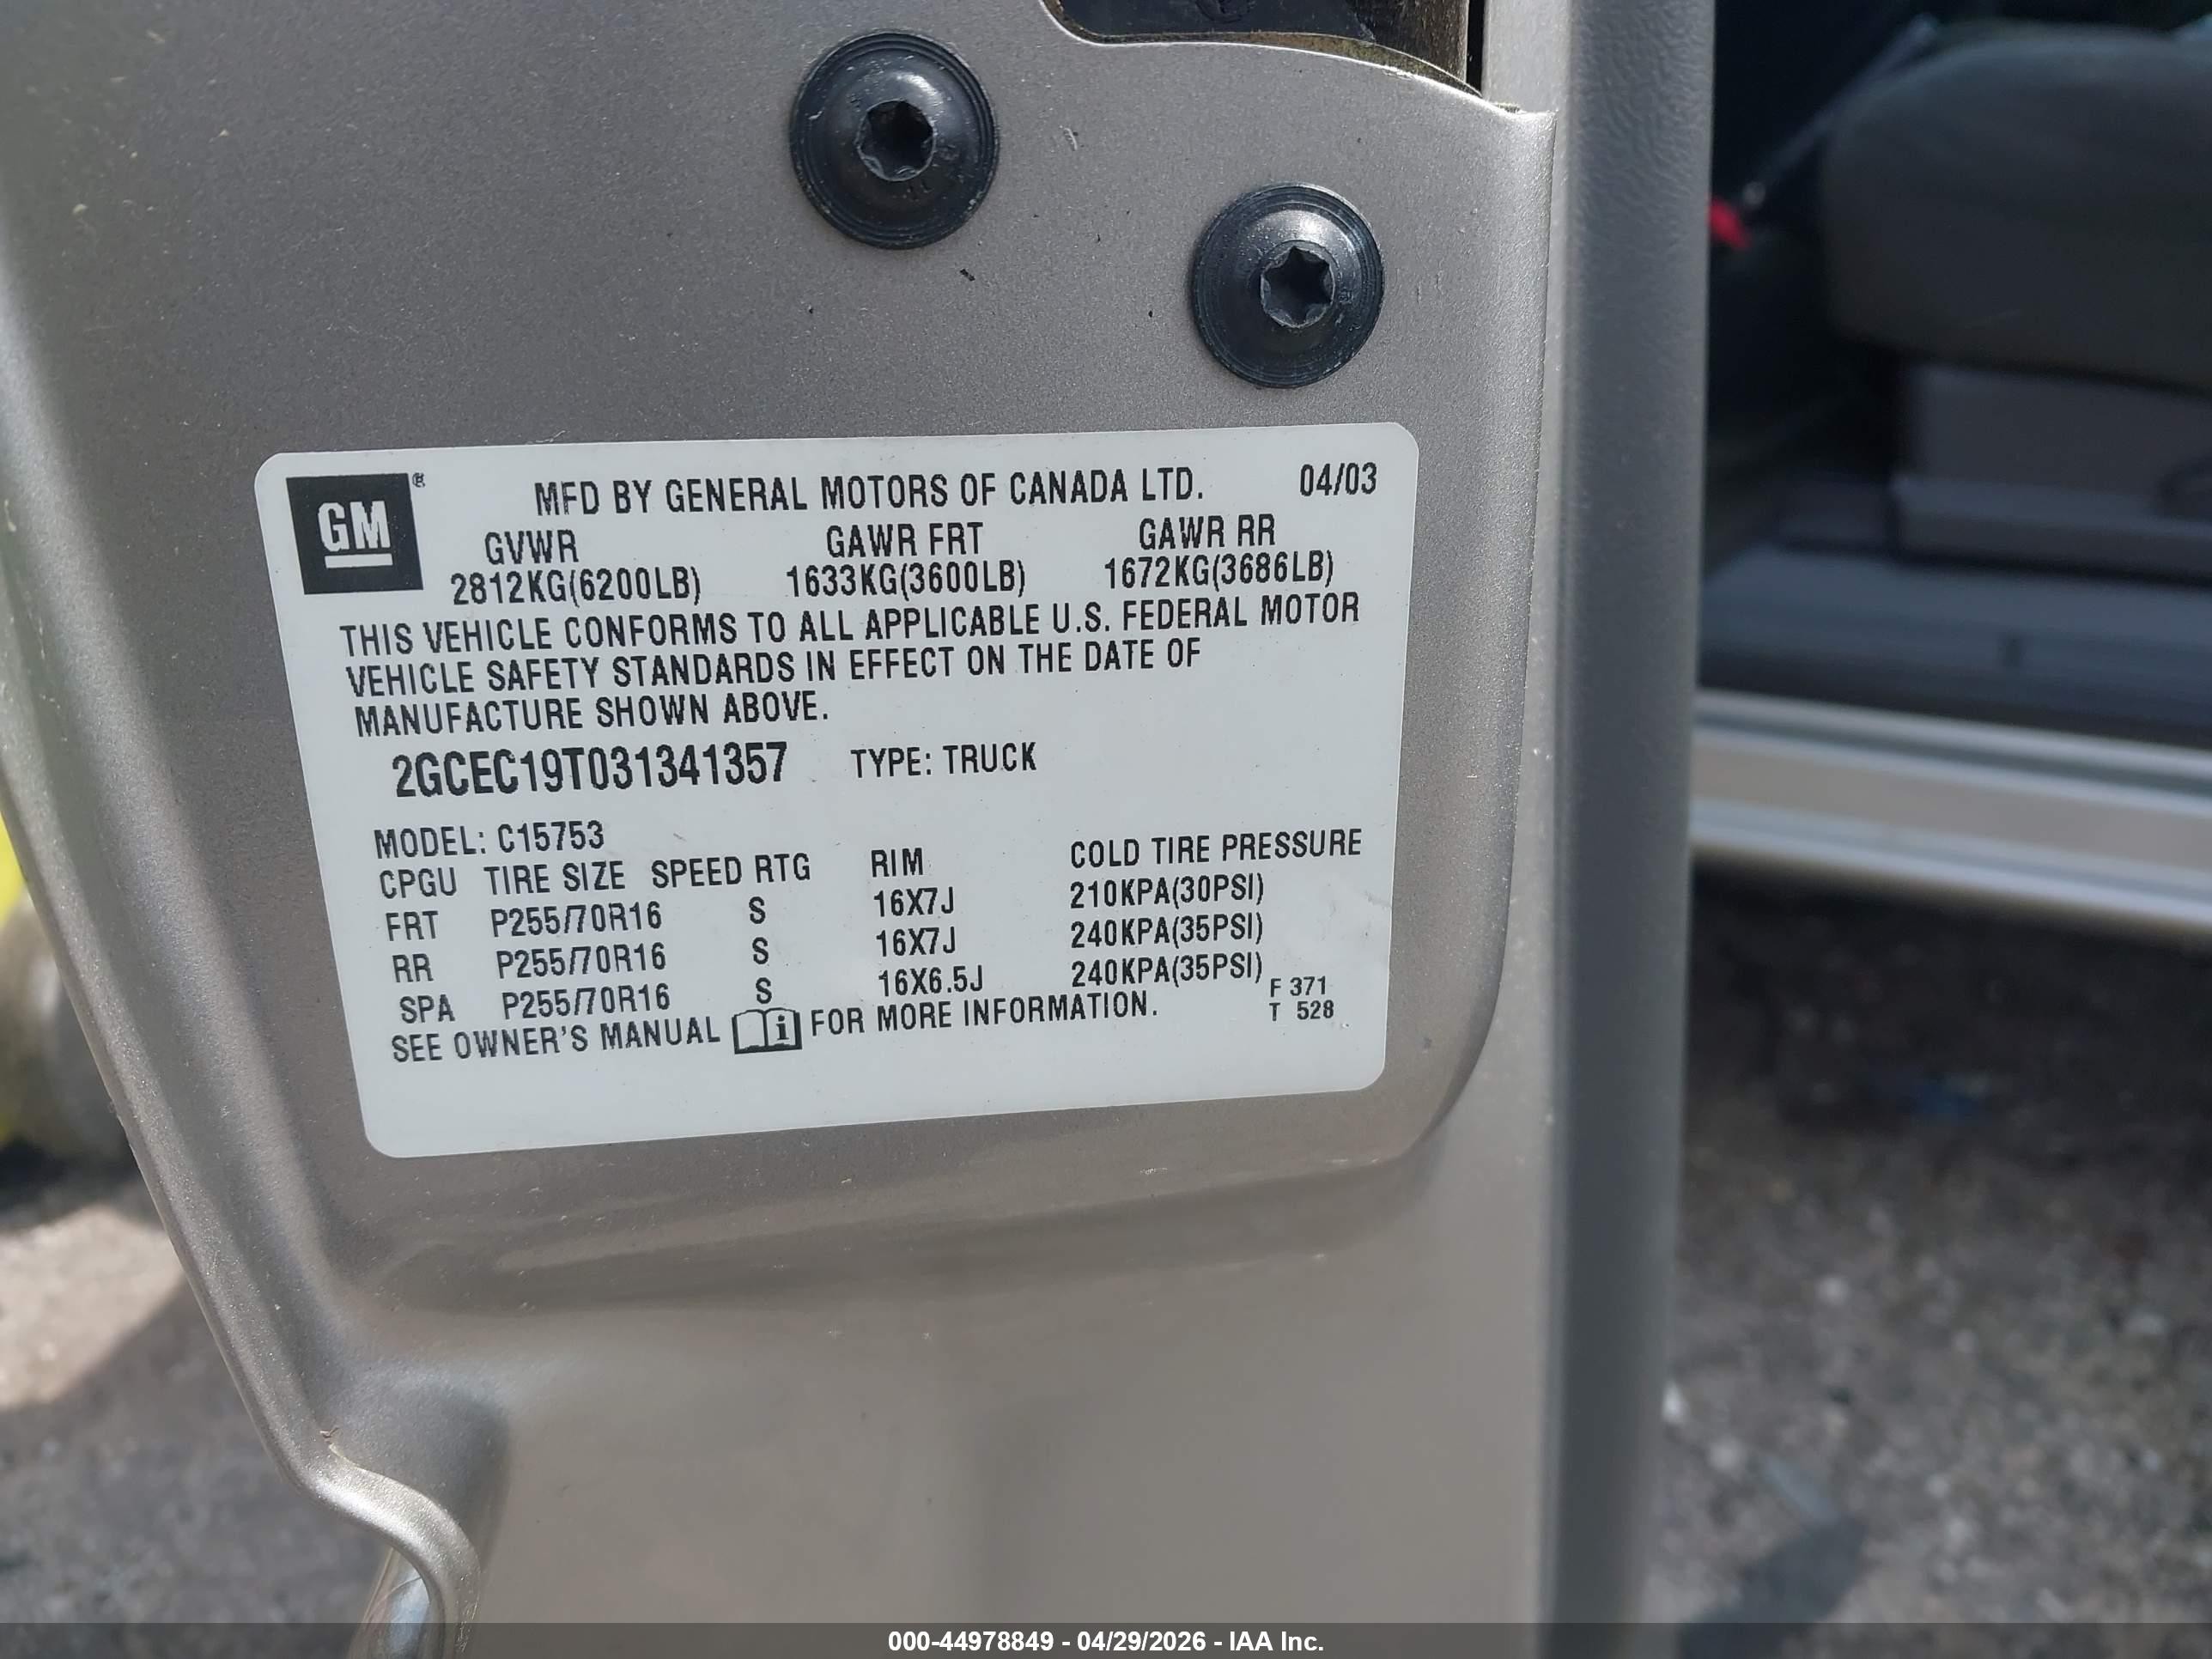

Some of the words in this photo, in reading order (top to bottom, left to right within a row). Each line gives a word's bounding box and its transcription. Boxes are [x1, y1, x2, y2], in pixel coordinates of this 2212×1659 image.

[534, 481, 599, 515] MFD
[613, 480, 652, 514] BY
[665, 477, 807, 513] GENERAL
[821, 474, 947, 509] MOTORS
[961, 473, 995, 506] OF
[1011, 469, 1127, 505] CANADA
[1143, 467, 1202, 501] LTD.
[1300, 462, 1376, 496] 04/03
[319, 501, 390, 551] GM
[827, 524, 917, 557] GAWR
[929, 522, 983, 555] FRT
[1139, 515, 1224, 550] GAWR
[1238, 514, 1274, 546] RR
[484, 529, 579, 565] GVWR
[451, 566, 701, 607] 2812KG(6200LB)
[787, 560, 1024, 601] 1633KG(3600LB)
[1104, 550, 1334, 592] 1672KG(3686LB)
[339, 623, 412, 656] THIS
[422, 617, 551, 653] VEHICLE
[565, 613, 737, 647] CONFORMS
[747, 611, 785, 643] TO
[799, 610, 854, 641] ALL
[866, 604, 1039, 640] APPLICABLE
[1053, 602, 1109, 633] U.S.
[1124, 597, 1247, 630] FEDERAL
[1261, 592, 1358, 625] MOTOR
[346, 661, 474, 697] VEHICLE
[487, 657, 599, 691] SAFETY
[613, 652, 794, 687] STANDARDS
[807, 651, 835, 681] IN
[850, 647, 954, 680] EFFECT
[968, 645, 1004, 675] ON
[1018, 642, 1072, 673] THE
[1085, 639, 1153, 671] DATE
[1168, 637, 1200, 667] OF
[355, 698, 582, 737] MANUFACTURE
[596, 694, 708, 727] SHOWN
[724, 690, 828, 723] ABOVE.
[392, 741, 787, 797] 2GCEC19T031341357
[850, 747, 931, 778] TYPE:
[943, 742, 1036, 774] TRUCK
[374, 826, 485, 859] MODEL:
[497, 820, 604, 853] C15753
[1071, 839, 1139, 868] COLD
[1152, 836, 1209, 864] TIRE
[1223, 829, 1362, 860] PRESSURE
[380, 867, 457, 899] CPGU
[483, 865, 550, 895] TIRE
[562, 860, 625, 891] SIZE
[652, 856, 742, 888] SPEED
[755, 853, 810, 883] RTG
[872, 848, 923, 878] RIM
[874, 886, 953, 917] 16X7J
[1071, 873, 1263, 909] 210KPA(30PSI)
[386, 910, 438, 941] FRT
[490, 901, 661, 937] P255/70R16
[749, 896, 766, 924] S
[876, 927, 955, 957] 16X7J
[1071, 912, 1262, 949] 240KPA(35PSI)
[392, 953, 433, 982] RR
[496, 942, 665, 979] P255/70R16
[752, 937, 769, 964] S
[878, 965, 982, 997] 16X6.5J
[1072, 951, 1261, 988] 240KPA(35PSI)
[1270, 978, 1281, 998] F
[1291, 975, 1326, 996] 371
[502, 983, 670, 1019] P255/70R16
[756, 977, 772, 1004] S
[399, 994, 455, 1024] SPA
[811, 1007, 865, 1036] FOR
[878, 1001, 951, 1031] MORE
[964, 991, 1157, 1026] INFORMATION.
[1269, 1002, 1280, 1022] T
[1297, 1000, 1334, 1020] 528
[392, 1034, 442, 1062] SEE
[454, 1025, 587, 1059] OWNER'S
[600, 1017, 720, 1050] MANUAL
